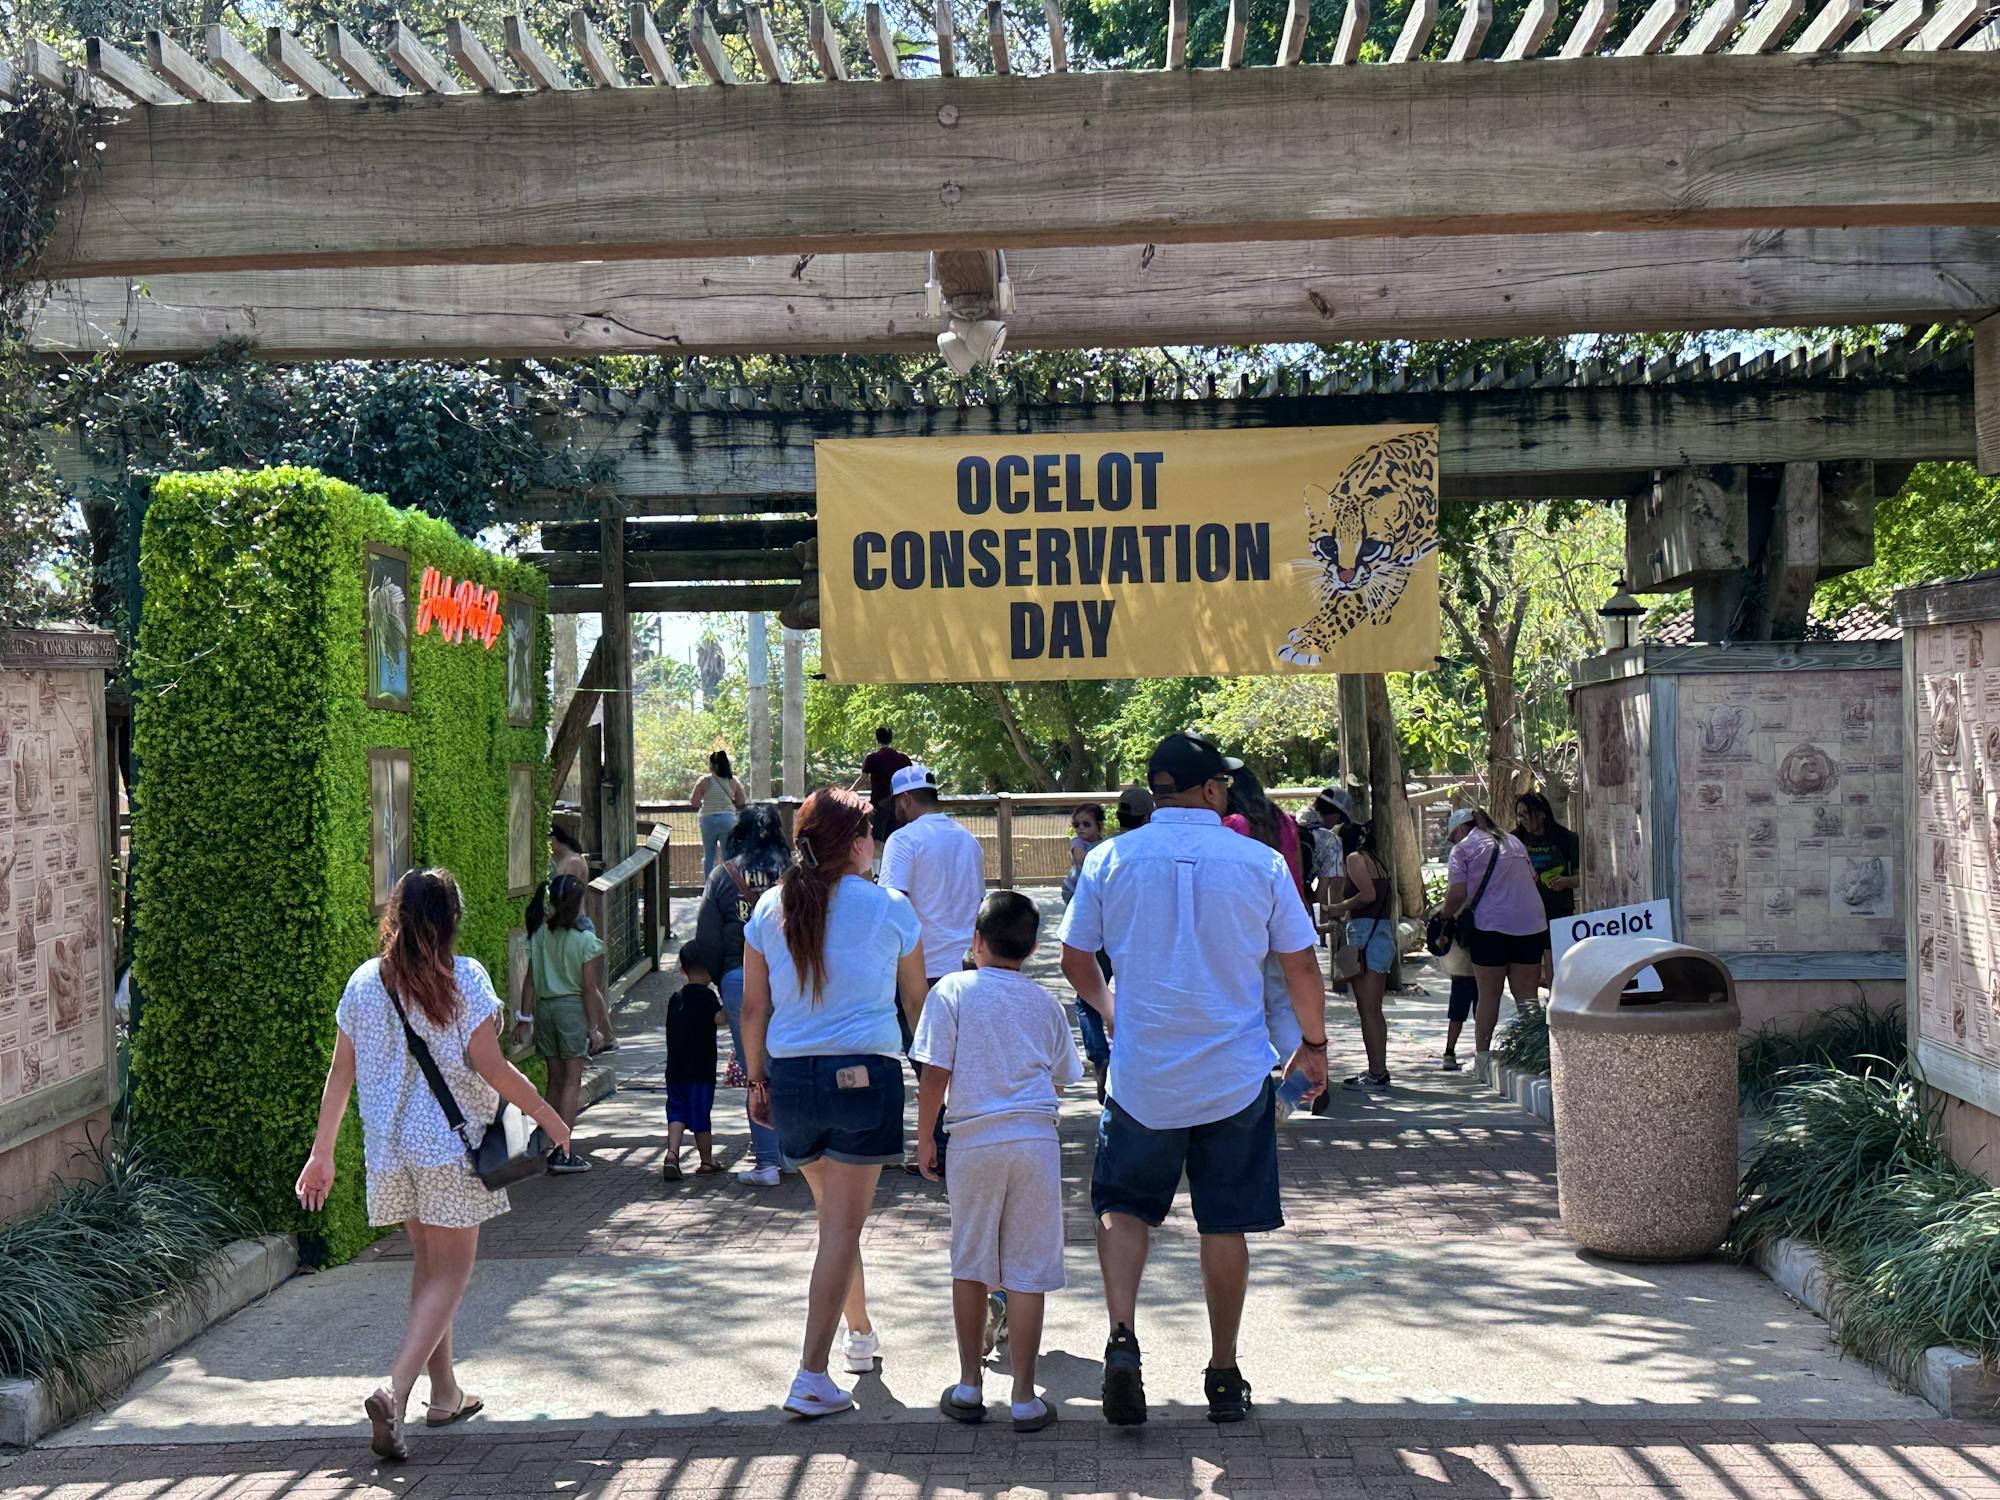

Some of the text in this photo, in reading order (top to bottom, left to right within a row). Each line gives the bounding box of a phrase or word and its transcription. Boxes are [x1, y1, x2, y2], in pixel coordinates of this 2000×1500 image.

[956, 451, 1164, 515] OCELOT
[852, 522, 1271, 591] CONSERVATION
[1010, 599, 1116, 660] DAY
[1572, 909, 1653, 942] Ocelot
